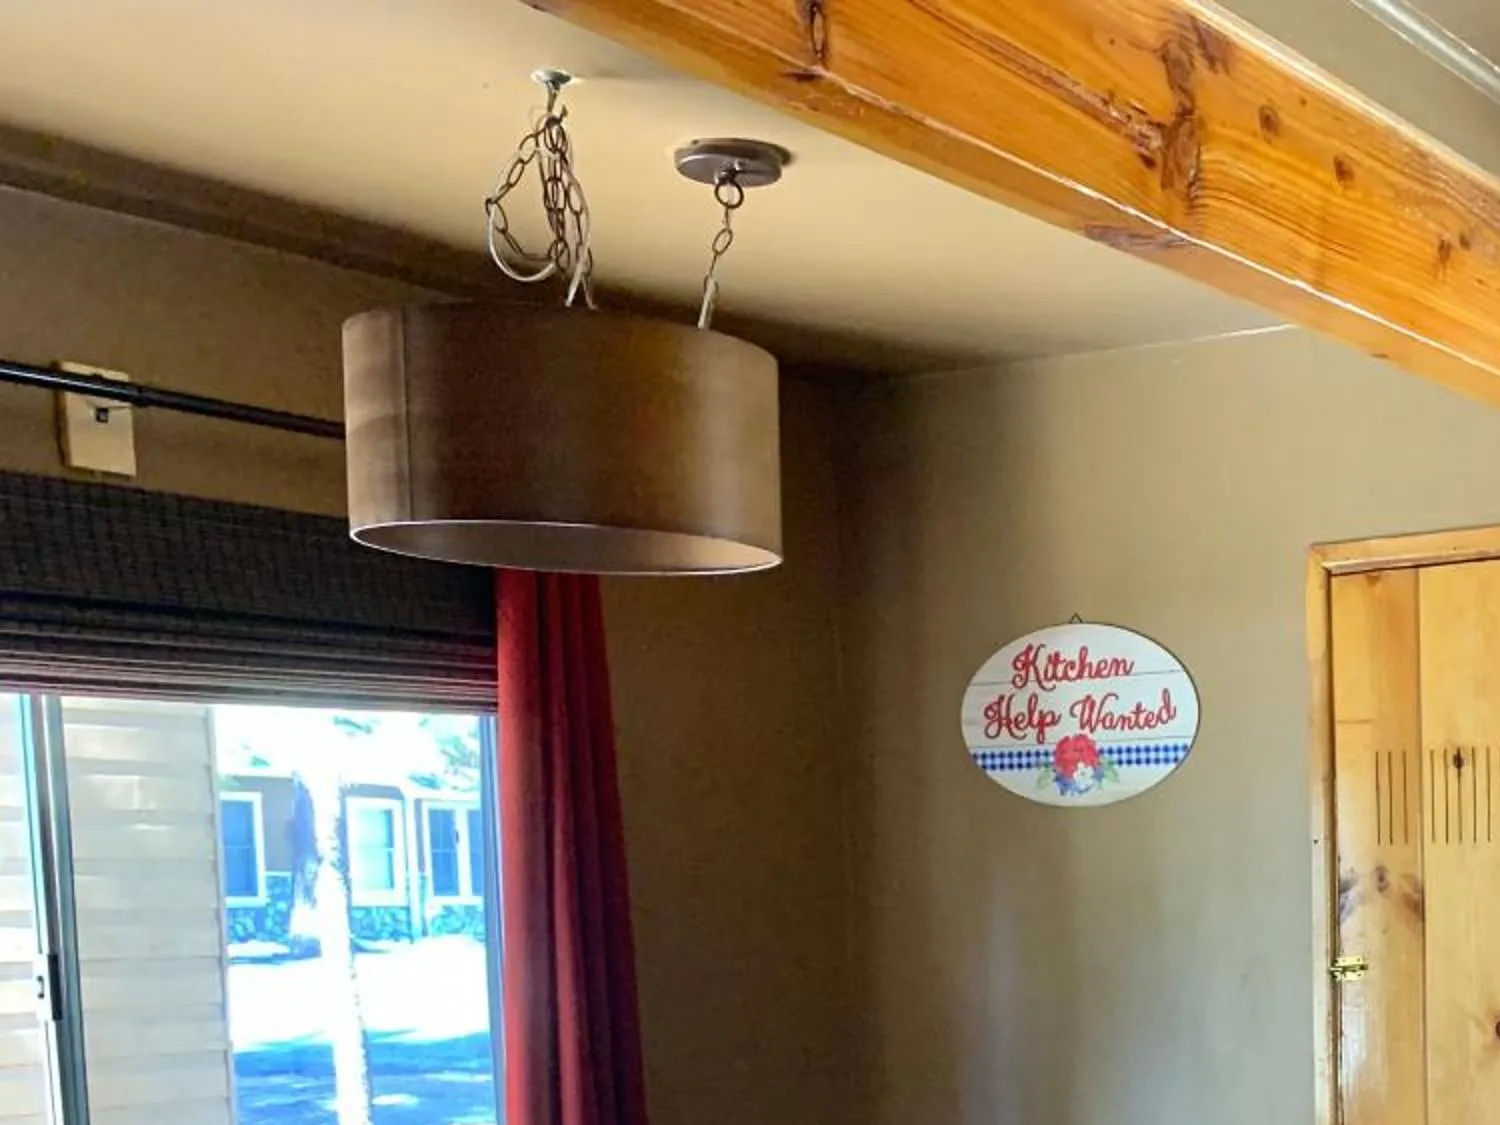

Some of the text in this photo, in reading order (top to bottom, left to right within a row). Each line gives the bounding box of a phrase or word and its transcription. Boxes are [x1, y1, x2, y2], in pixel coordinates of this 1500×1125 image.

[1012, 644, 1135, 691] Kitchen
[984, 688, 1177, 745] Help Wanted
